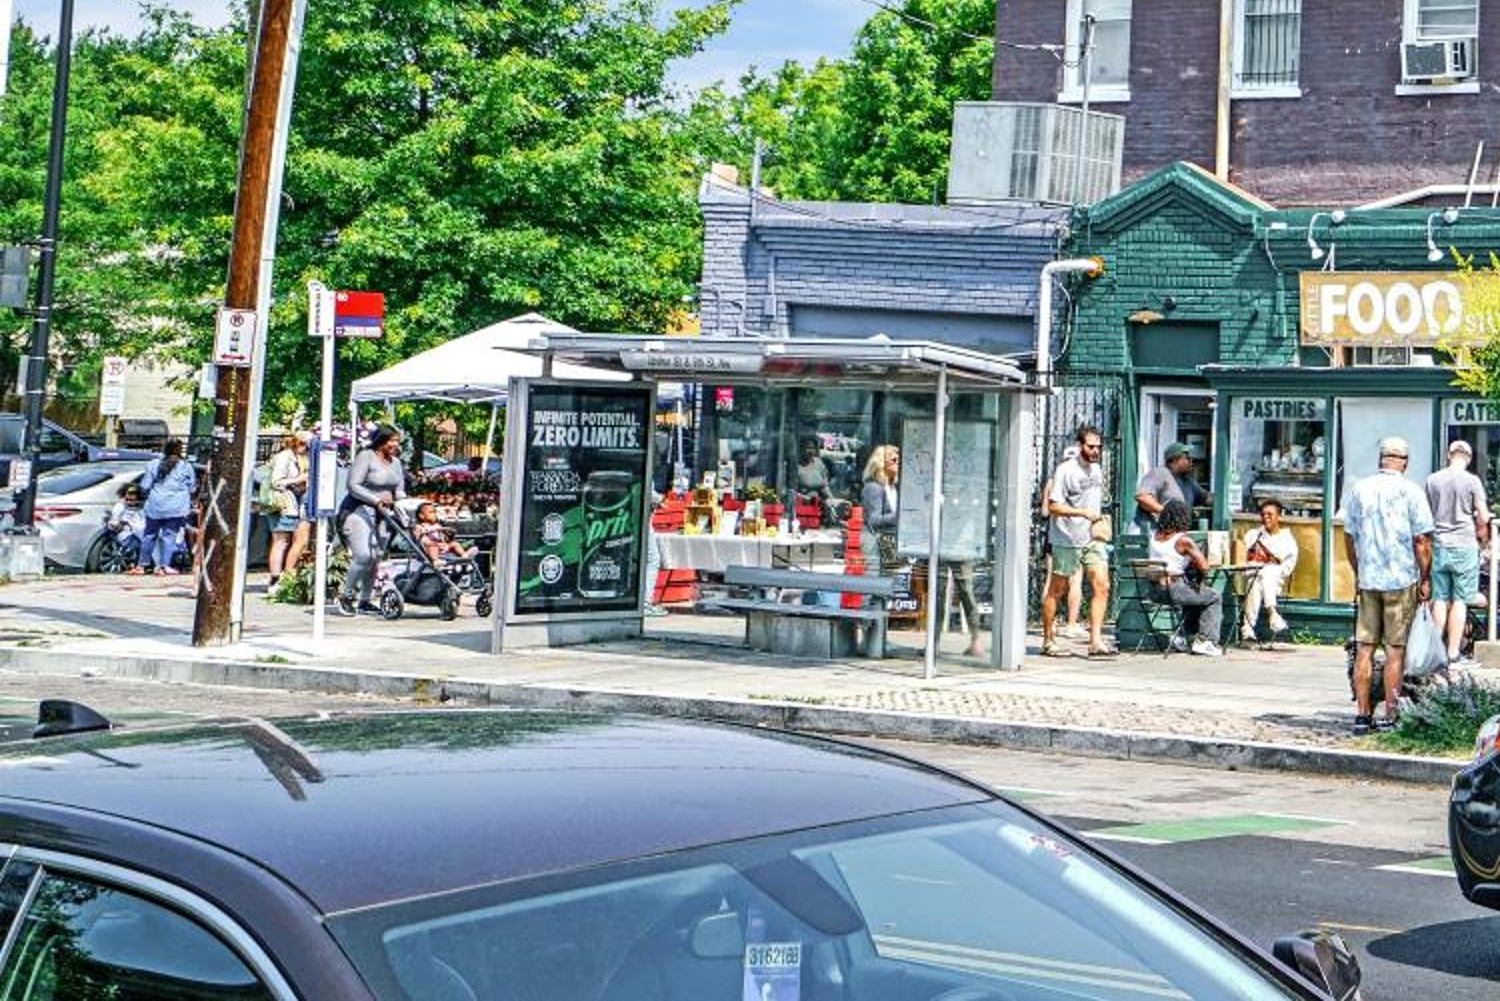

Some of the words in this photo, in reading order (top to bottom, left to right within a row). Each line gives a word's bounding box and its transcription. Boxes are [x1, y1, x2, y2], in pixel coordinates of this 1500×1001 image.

[1321, 281, 1462, 336] FOOD
[533, 410, 579, 424] INFINITE
[581, 412, 641, 426] POTENTIAL.
[1244, 400, 1316, 419] PASTRIES
[532, 426, 579, 446] ZERO
[582, 427, 640, 448] LIMITS.
